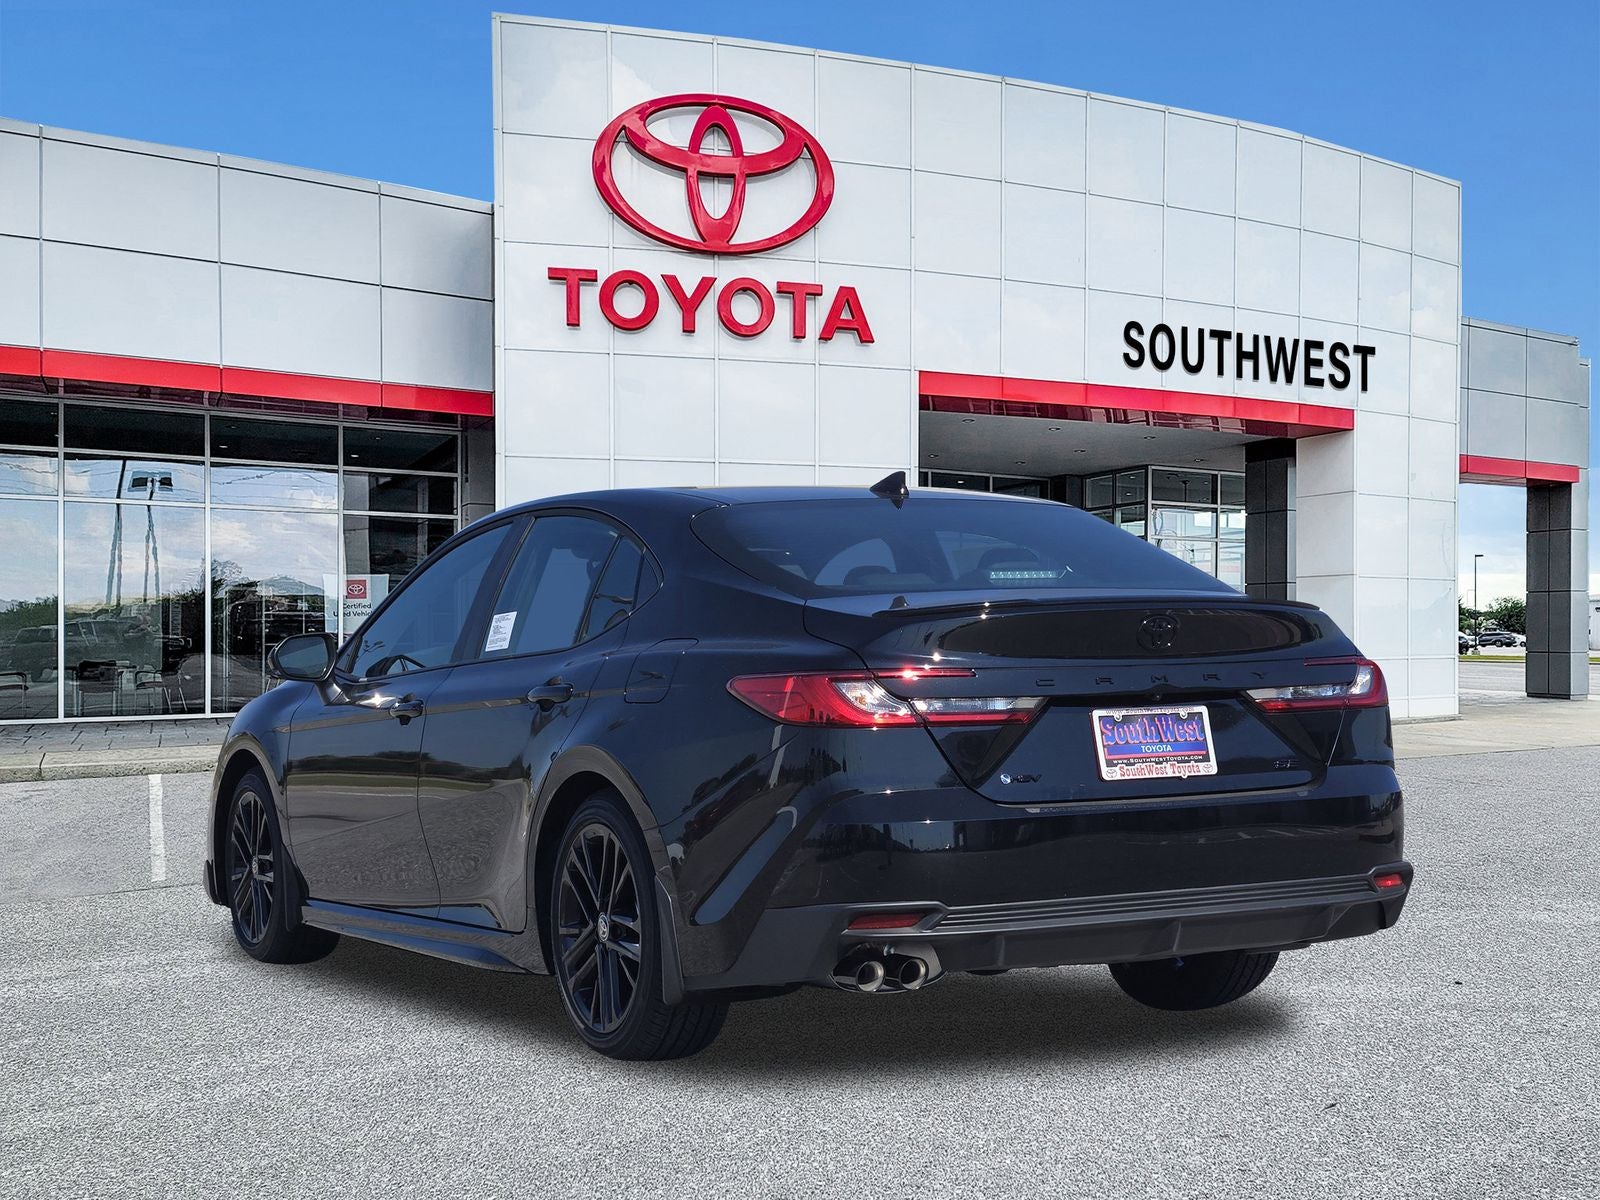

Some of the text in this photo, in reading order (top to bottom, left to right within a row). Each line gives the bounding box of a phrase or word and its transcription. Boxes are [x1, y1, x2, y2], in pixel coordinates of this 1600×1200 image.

[547, 266, 875, 344] TOYOTA
[1123, 320, 1376, 392] SOUTHWEST
[1035, 671, 1268, 687] CAMRY
[1141, 745, 1173, 753] TOYOTA
[1119, 762, 1201, 777] SouthWest Toyota
